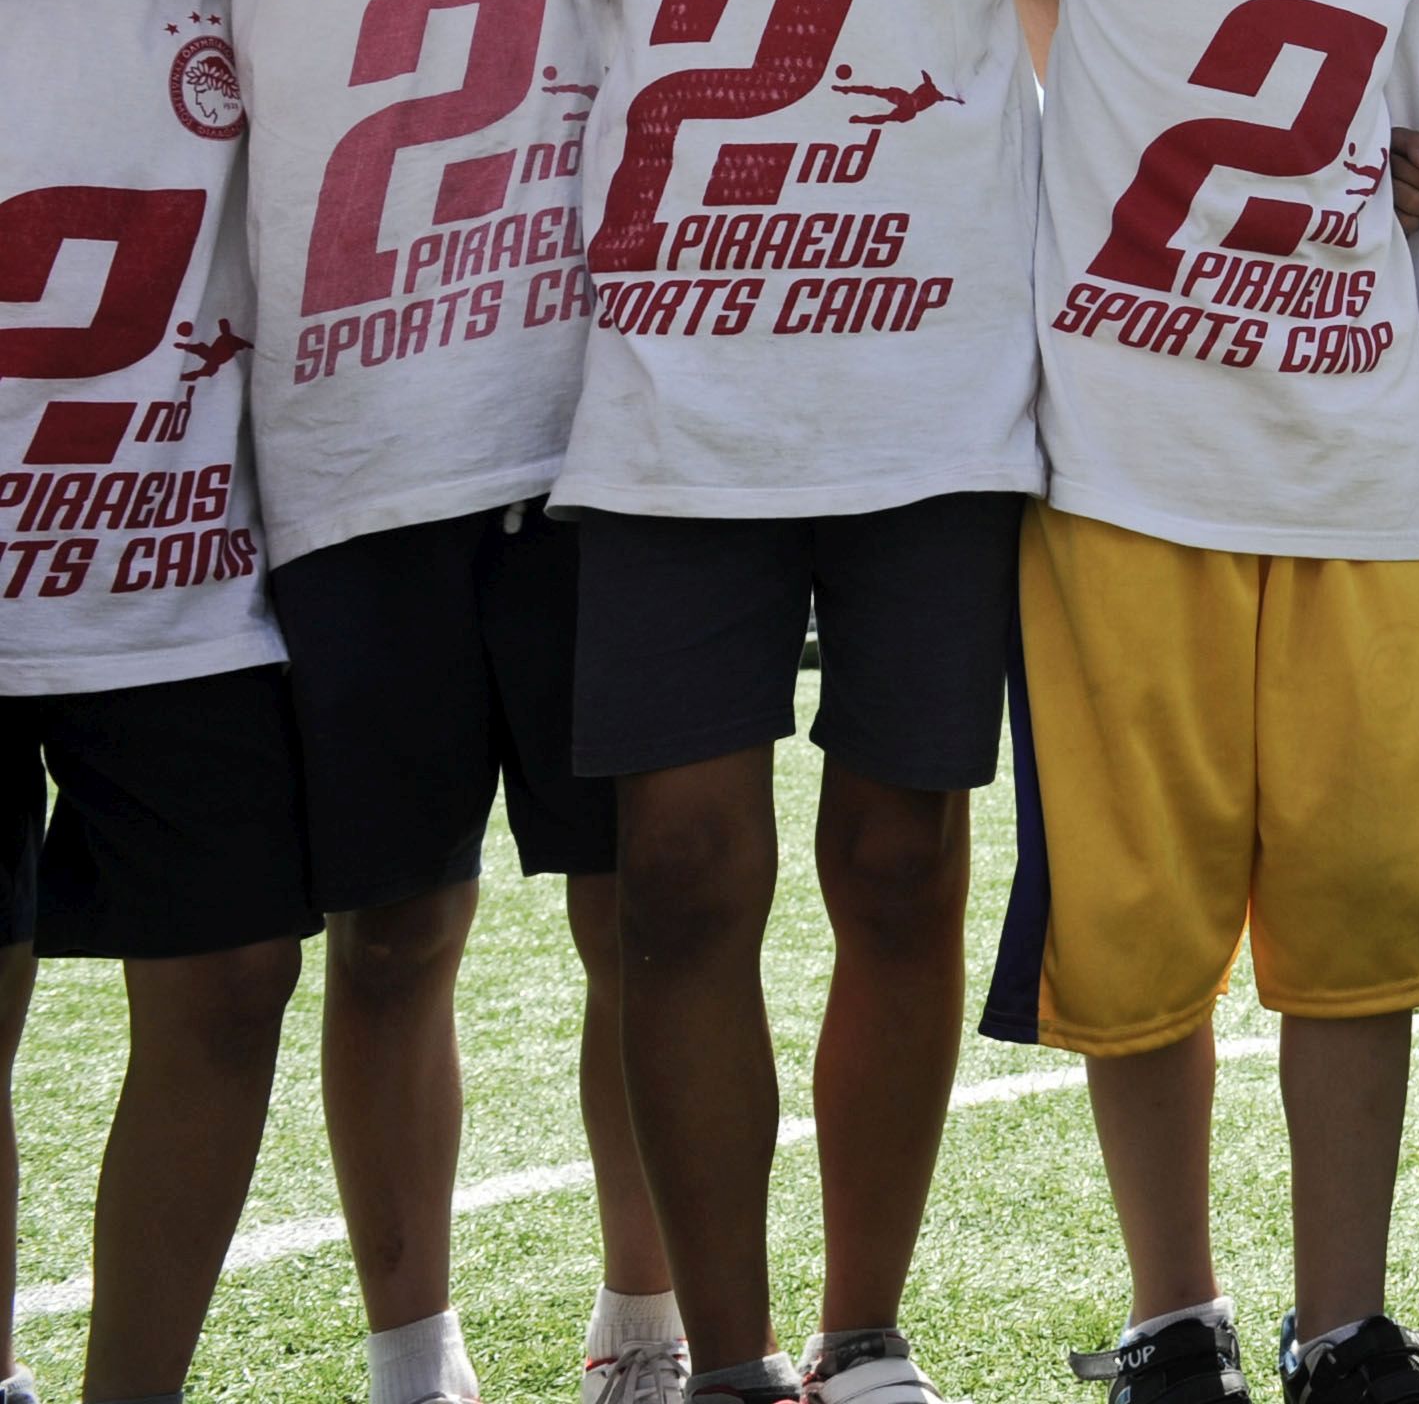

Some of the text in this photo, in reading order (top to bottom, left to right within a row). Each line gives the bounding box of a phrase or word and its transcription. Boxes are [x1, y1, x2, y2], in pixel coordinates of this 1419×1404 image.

[667, 212, 910, 271] PIRAEUS
[772, 278, 953, 335] CAMP
[1181, 251, 1376, 320] PIRAEUS
[293, 286, 503, 384] SPORTS
[1051, 282, 1394, 375] SPORTS CAMP
